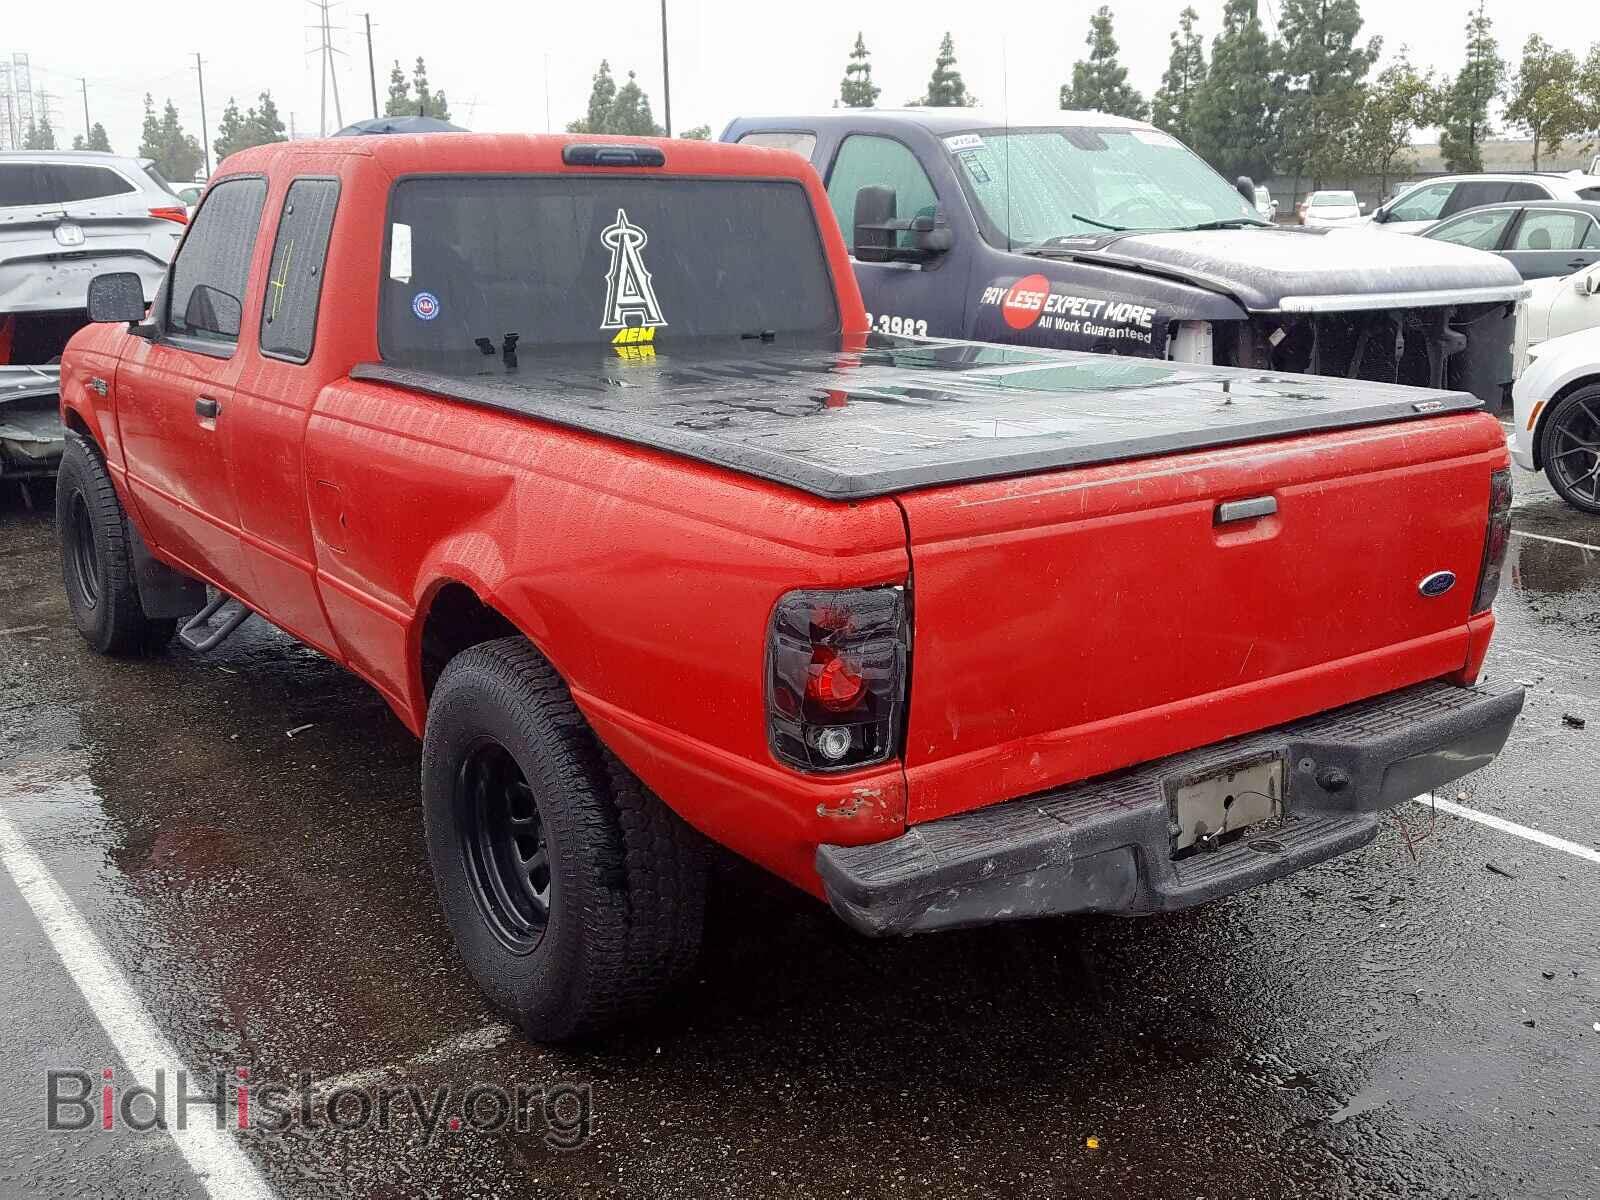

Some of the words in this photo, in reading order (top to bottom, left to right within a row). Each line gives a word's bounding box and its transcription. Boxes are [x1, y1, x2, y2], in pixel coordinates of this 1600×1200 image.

[980, 286, 1009, 305] PAY
[1005, 288, 1046, 310] LESS
[1043, 294, 1106, 318] EXPECT
[1103, 301, 1157, 329] MORE
[611, 326, 656, 344] AEM
[1038, 315, 1053, 329] All
[1055, 316, 1081, 333] Work
[1083, 321, 1152, 344] Guaranteed
